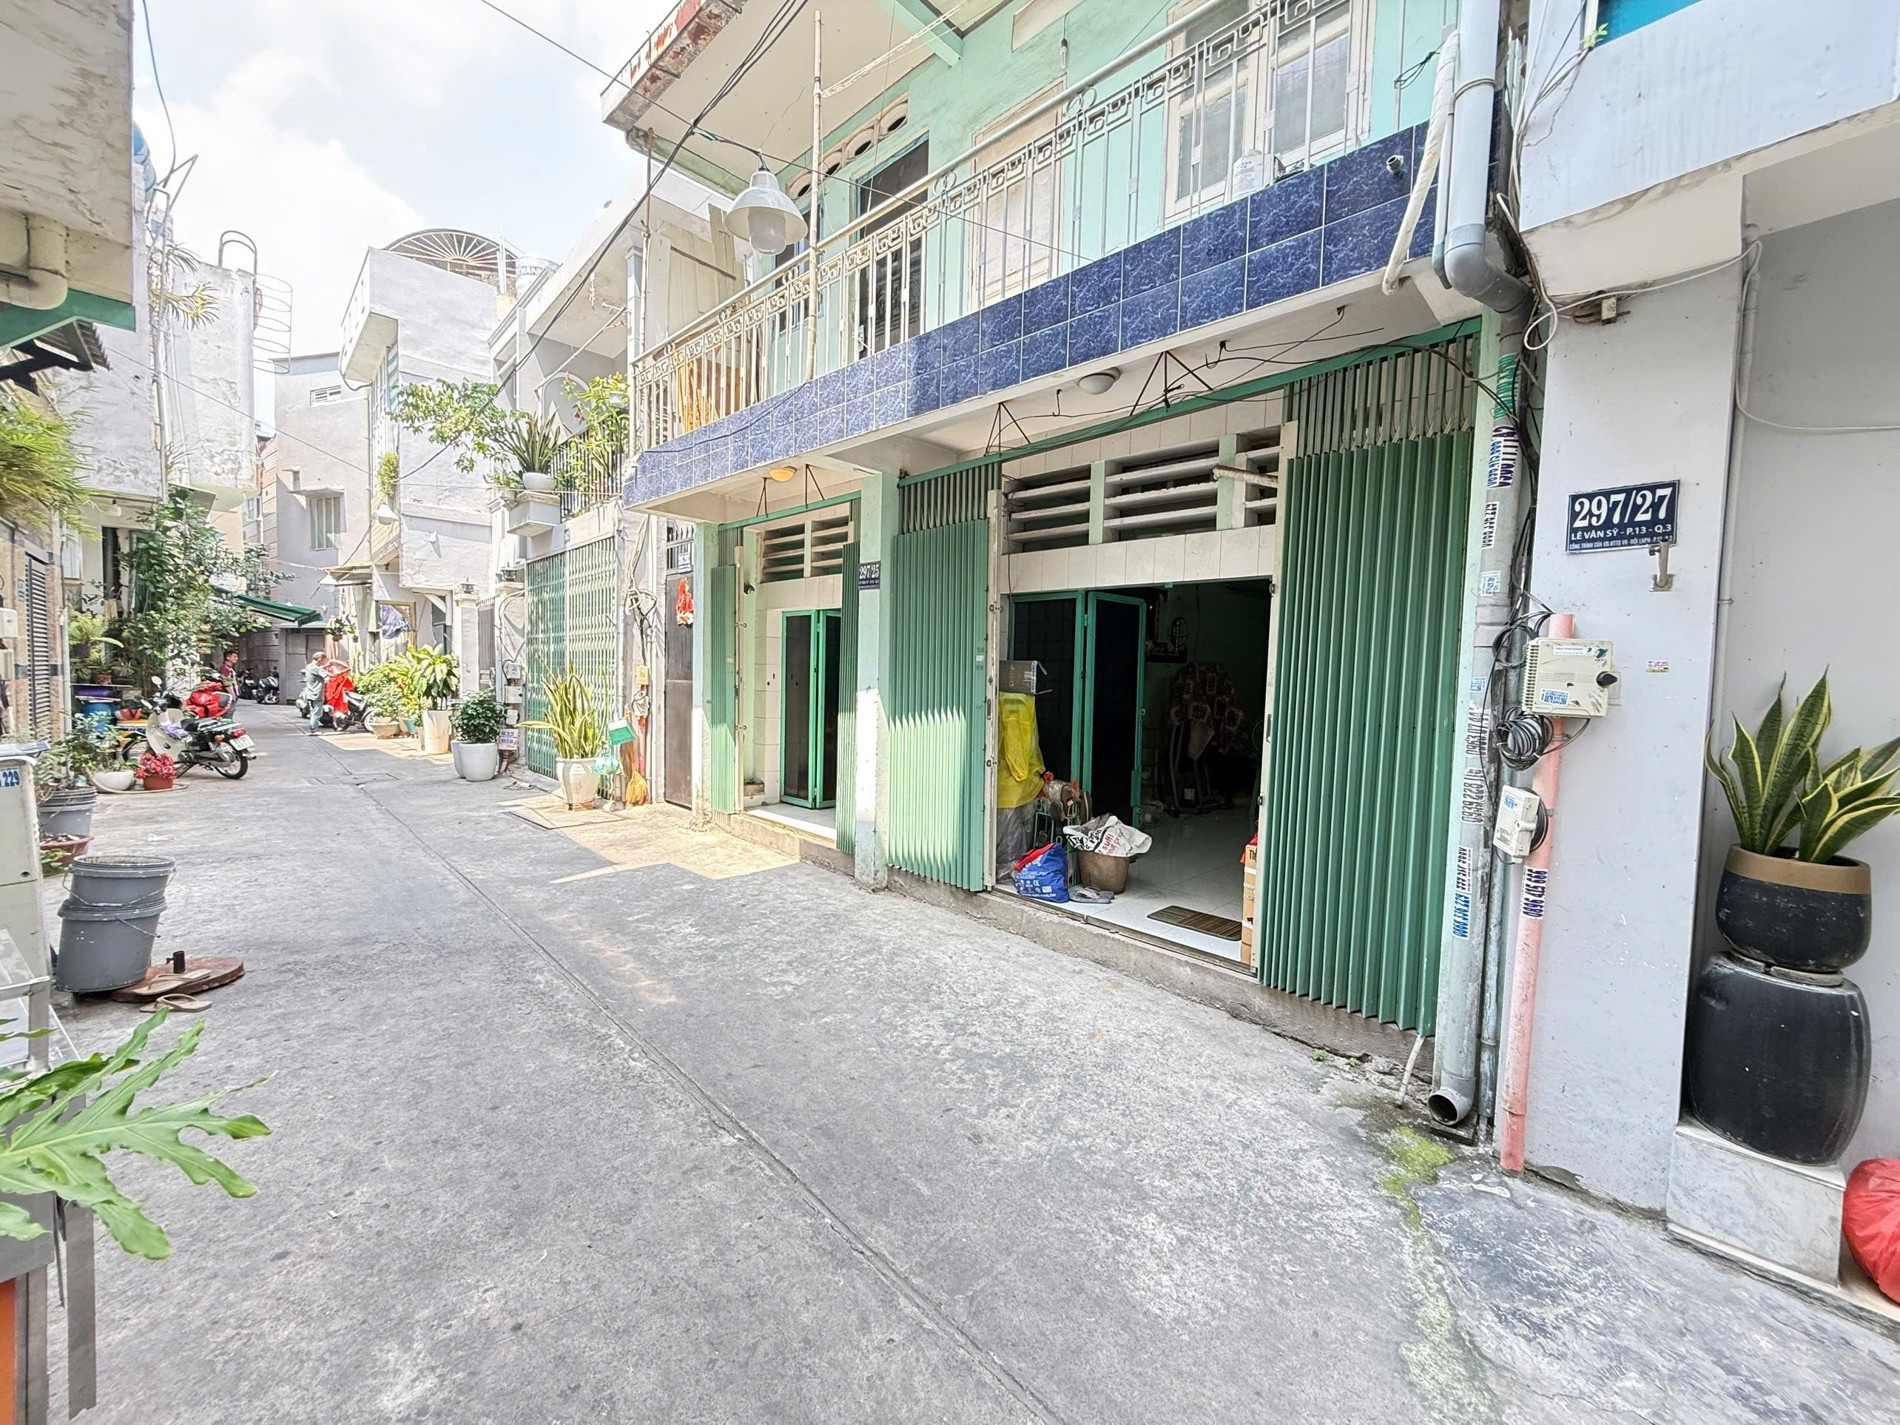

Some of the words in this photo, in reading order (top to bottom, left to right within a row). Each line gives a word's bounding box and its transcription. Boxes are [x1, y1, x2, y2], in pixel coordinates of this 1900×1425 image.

[1573, 486, 1673, 528] 297/27
[1571, 530, 1582, 541] LÊ
[1583, 528, 1604, 539] VĂN
[1606, 527, 1619, 538] SỸ
[1626, 526, 1647, 536] P.13
[1654, 524, 1672, 533] Q.3
[2, 770, 20, 787] 229
